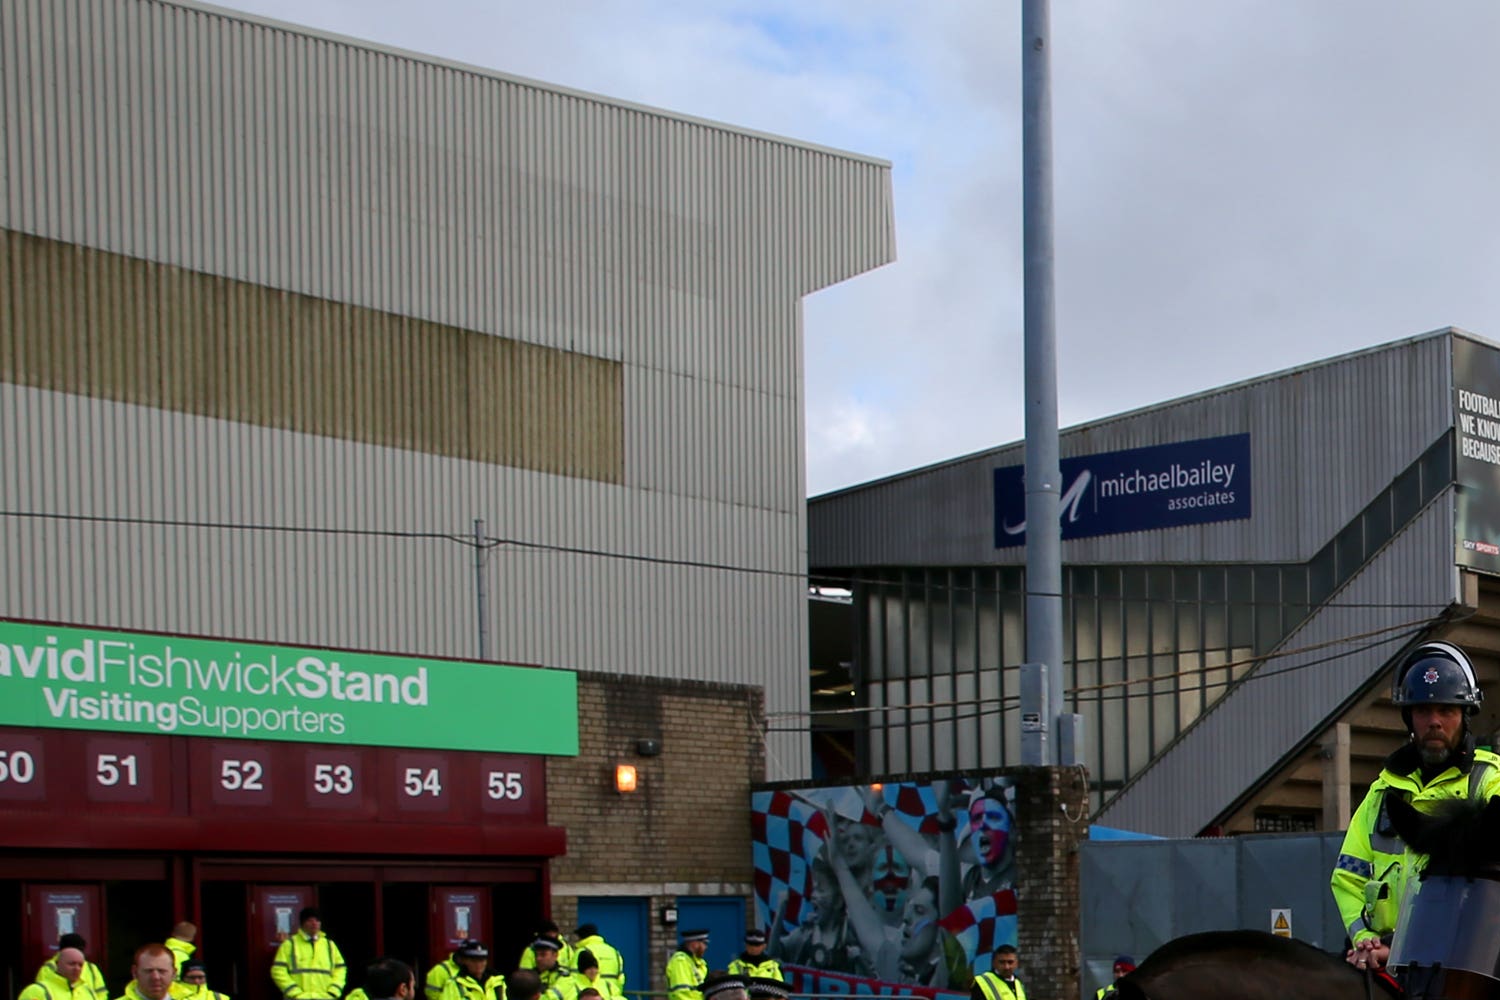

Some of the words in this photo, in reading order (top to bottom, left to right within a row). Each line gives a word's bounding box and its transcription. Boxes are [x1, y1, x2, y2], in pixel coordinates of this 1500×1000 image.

[1460, 413, 1476, 435] WE
[1462, 437, 1500, 465] BECAUSE
[1101, 460, 1235, 498] michaelbailey
[1168, 490, 1235, 510] associates
[43, 686, 346, 735] VisitingSupporters
[96, 754, 137, 786] 51
[221, 759, 263, 790] 52
[314, 764, 354, 794] 53
[404, 768, 442, 797] 54
[488, 772, 522, 800] 55
